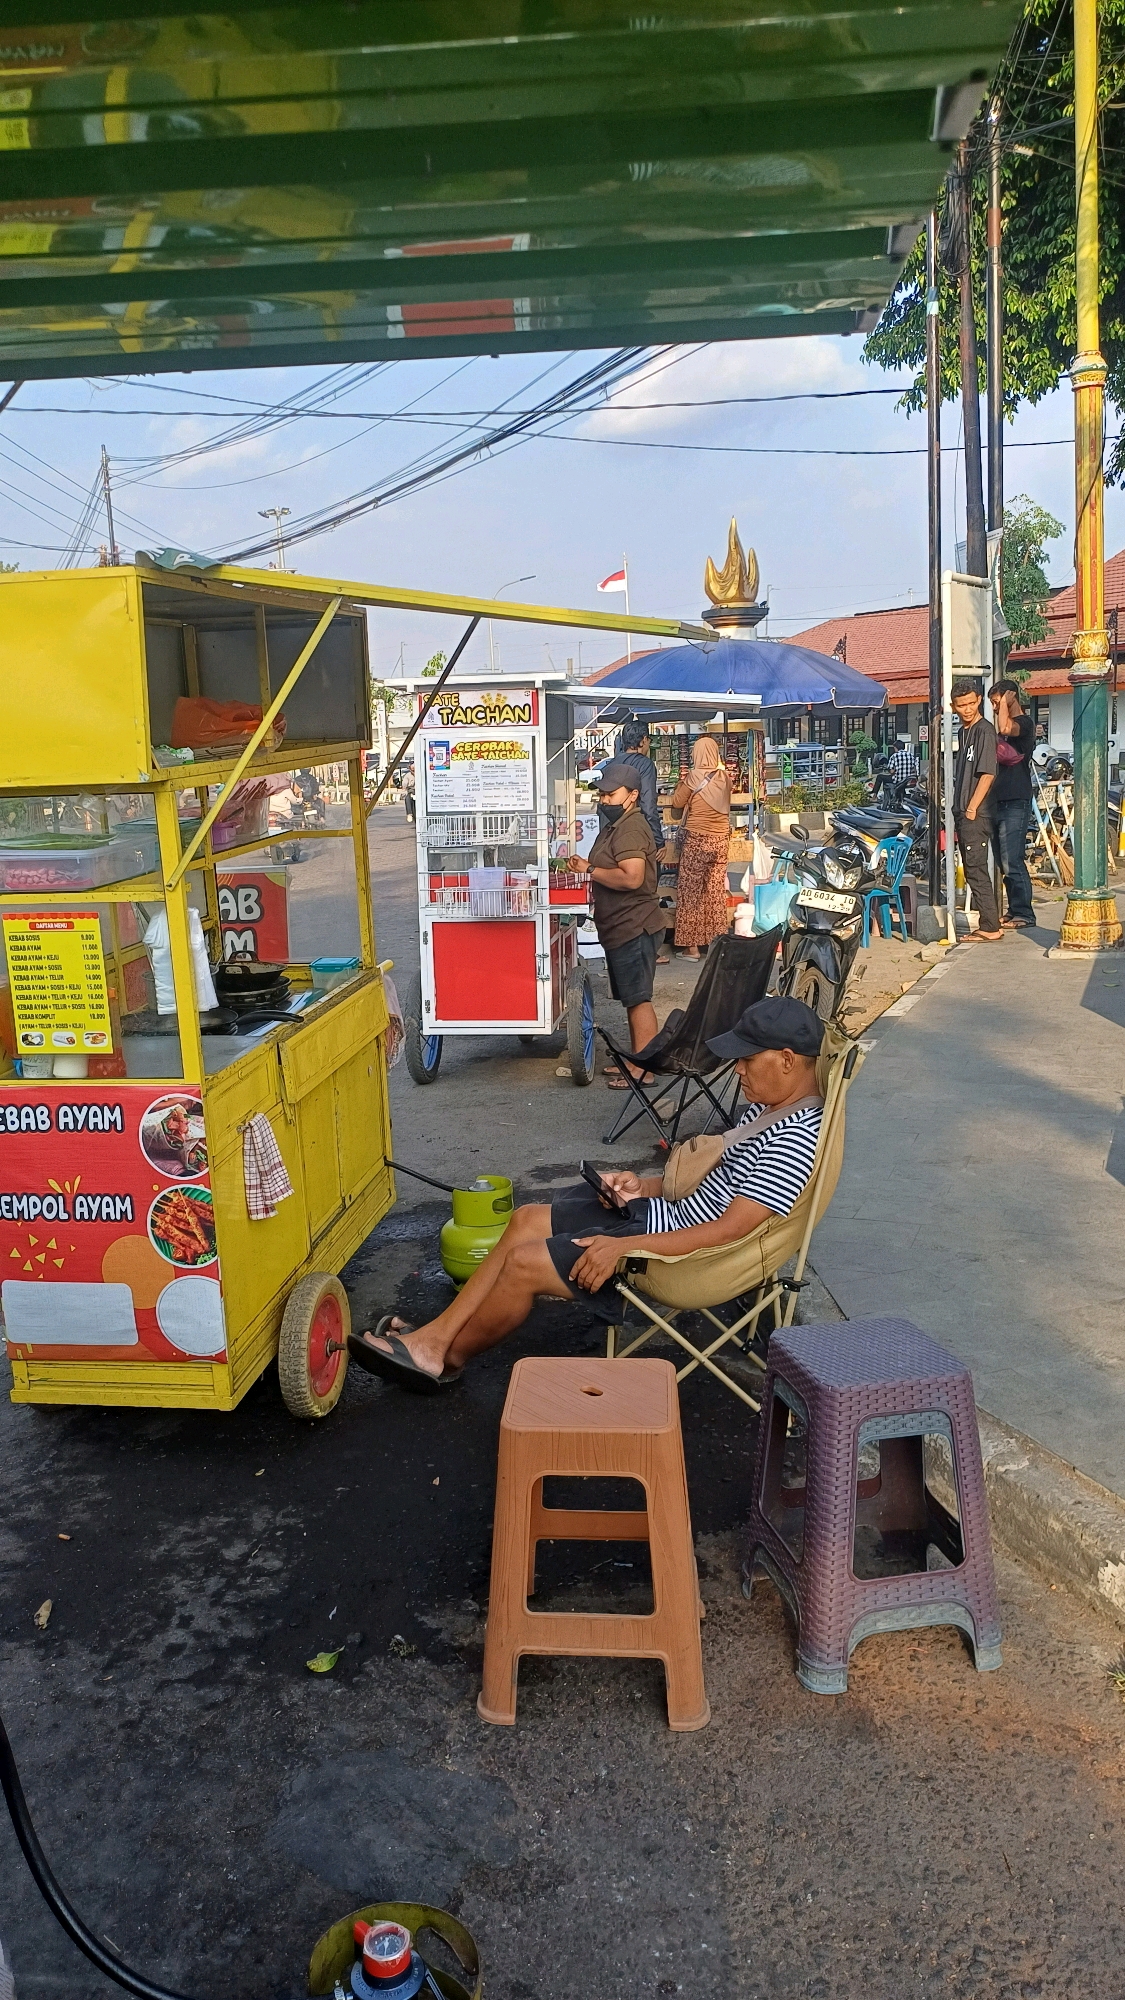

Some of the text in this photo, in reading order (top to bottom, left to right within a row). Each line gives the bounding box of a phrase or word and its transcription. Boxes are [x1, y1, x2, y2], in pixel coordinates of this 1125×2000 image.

[438, 703, 531, 726] TAICHAN
[451, 751, 530, 761] SATE TAICHAN
[58, 1105, 123, 1131] AYAM
[0, 1194, 133, 1221] EMPOL AYAM
